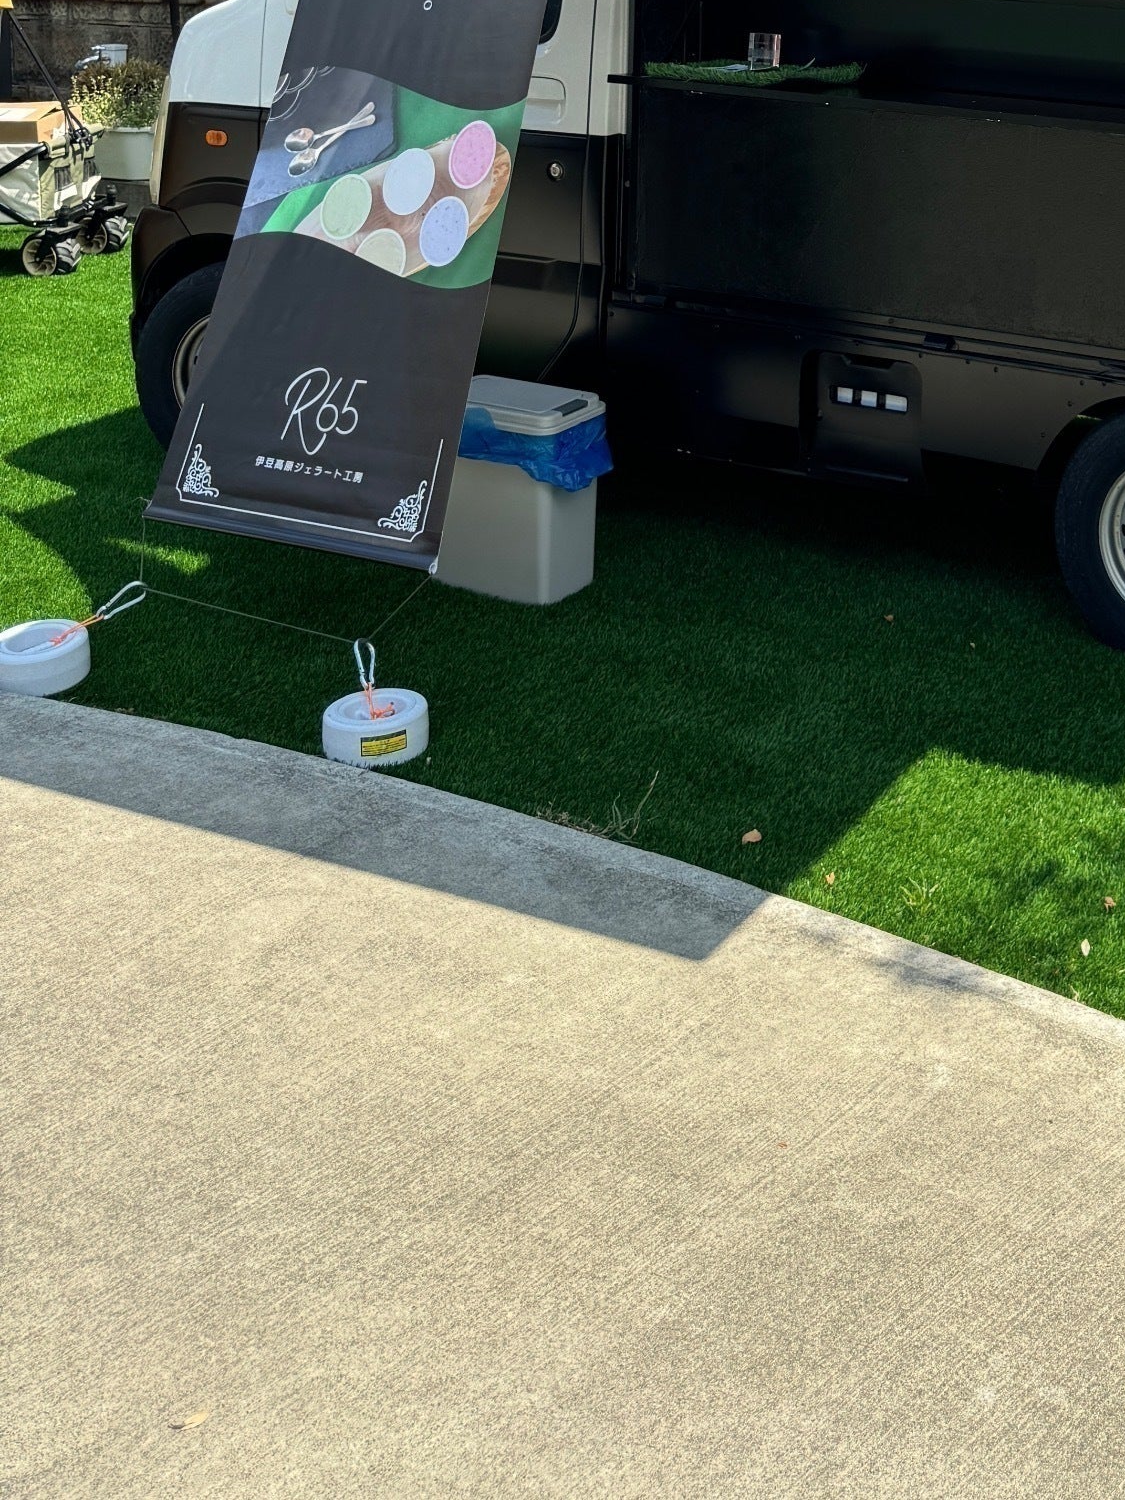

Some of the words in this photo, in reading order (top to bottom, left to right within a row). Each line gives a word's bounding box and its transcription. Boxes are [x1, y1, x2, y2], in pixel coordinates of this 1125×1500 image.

[280, 367, 368, 456] R65
[255, 455, 363, 484] 伊豆高原ジェラート工房
